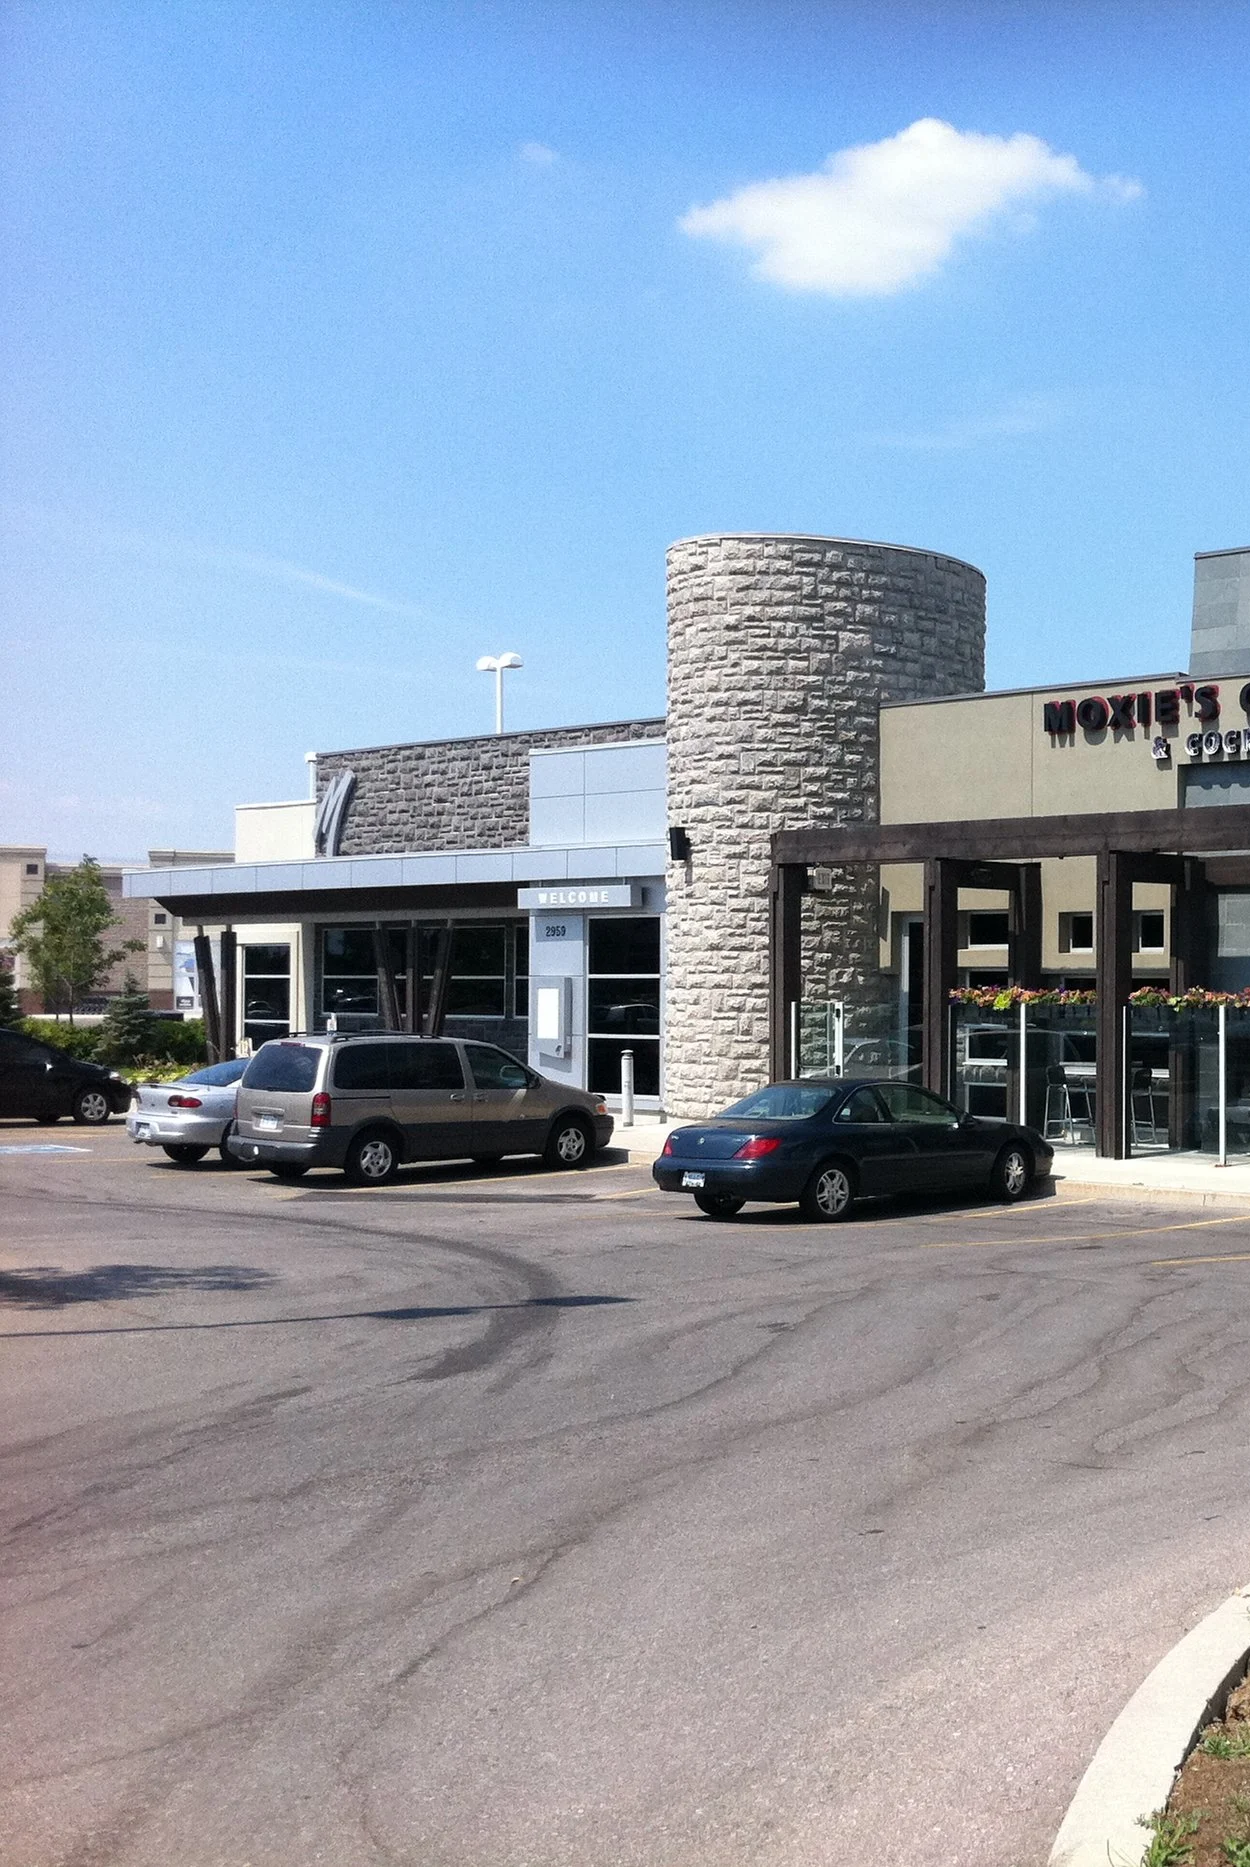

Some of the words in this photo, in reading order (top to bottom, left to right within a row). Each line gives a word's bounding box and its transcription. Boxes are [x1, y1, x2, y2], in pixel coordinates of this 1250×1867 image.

[1044, 684, 1220, 733] MOXIE'S
[1151, 736, 1171, 760] &
[538, 891, 608, 904] WELCOME
[545, 926, 566, 937] 2959
